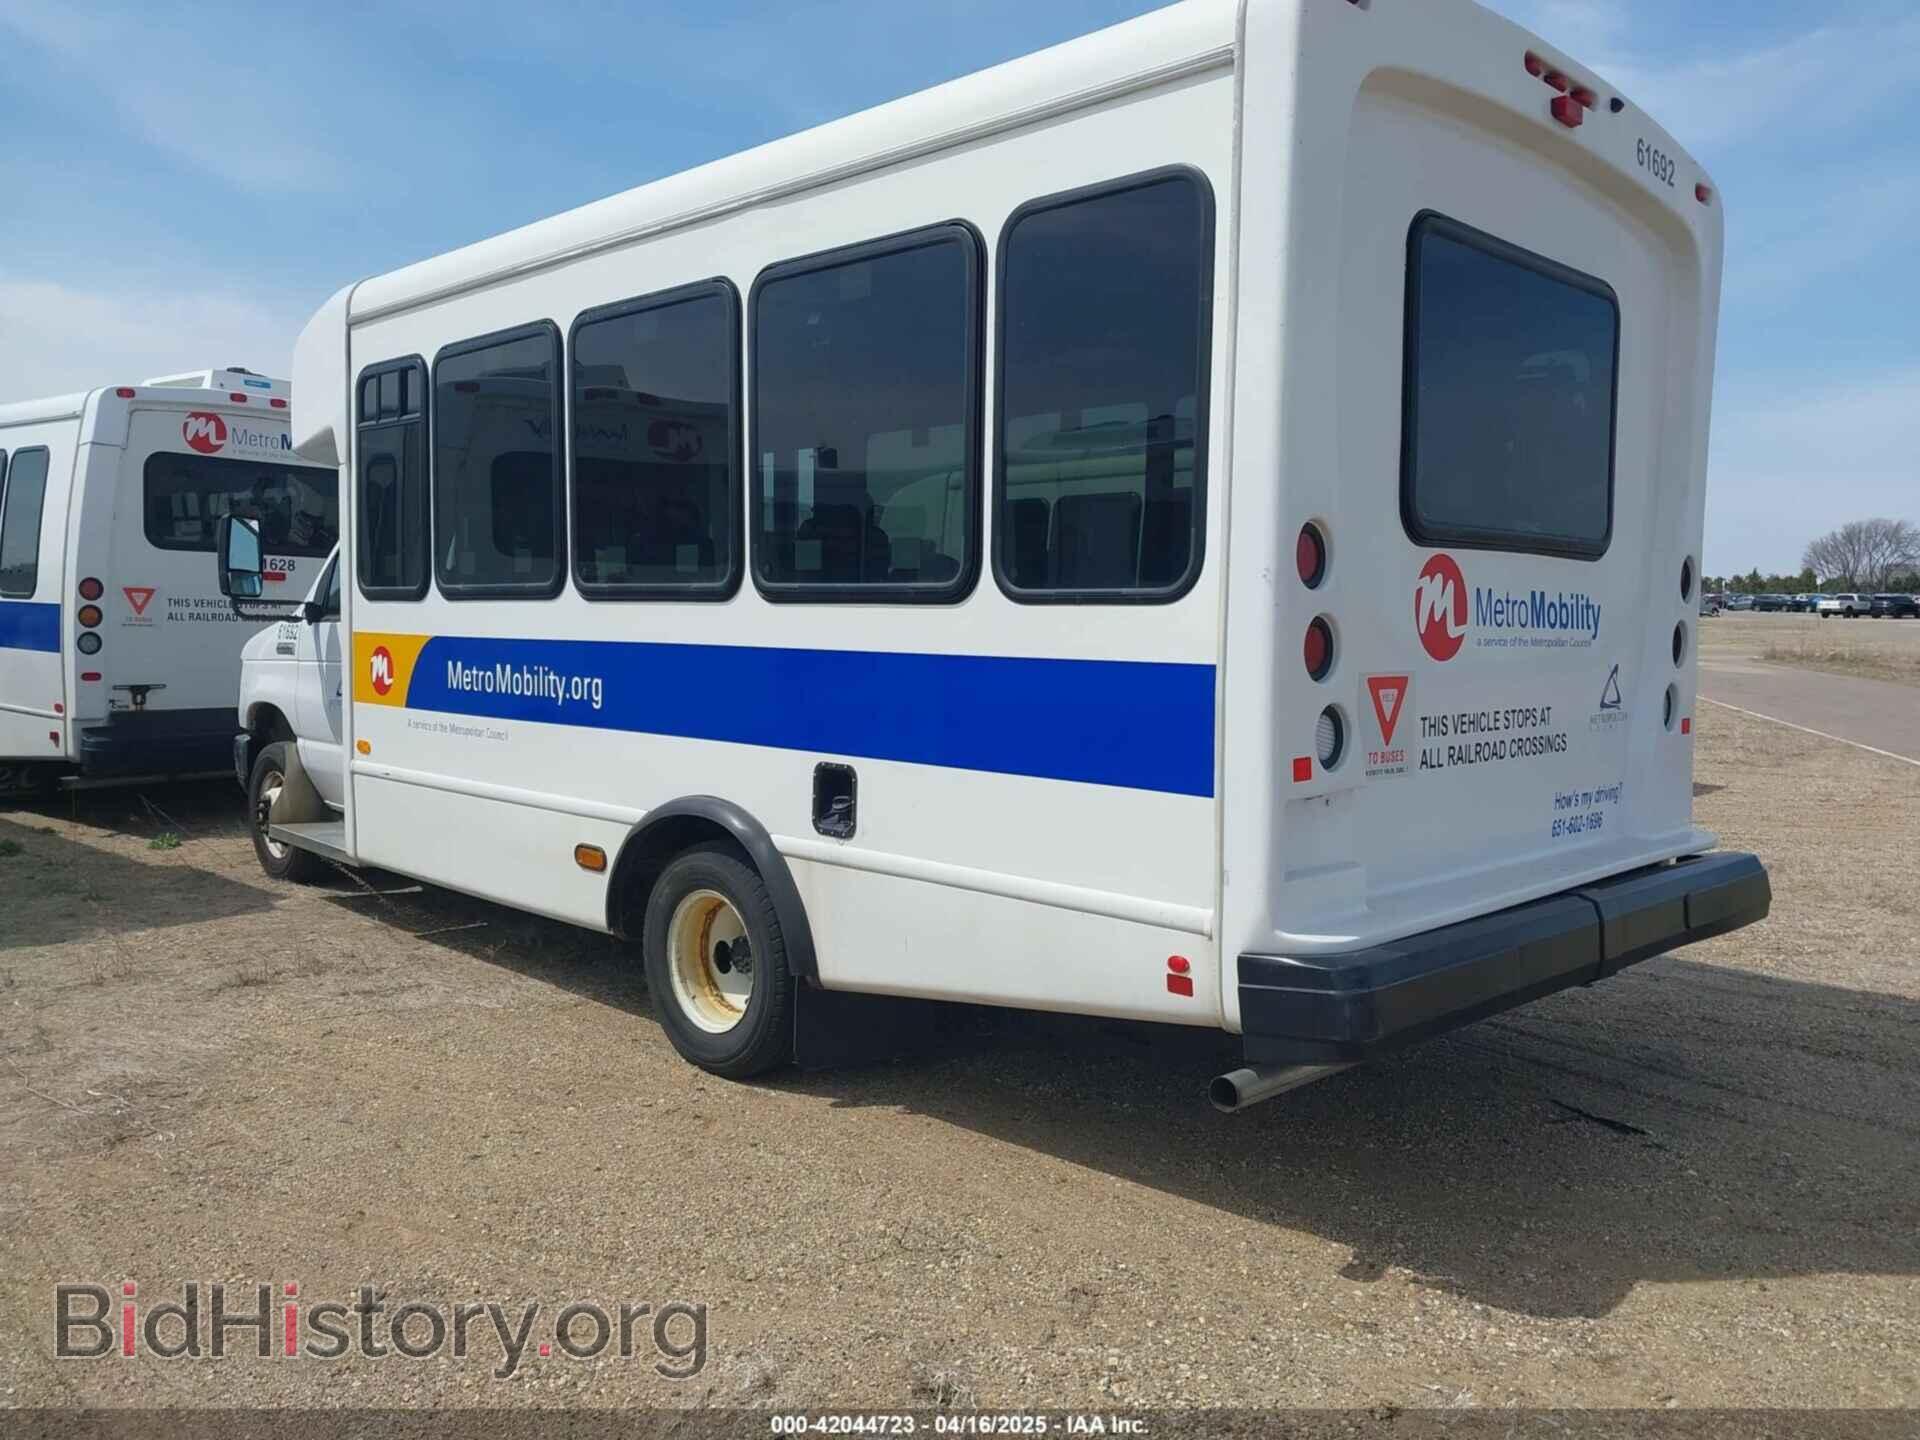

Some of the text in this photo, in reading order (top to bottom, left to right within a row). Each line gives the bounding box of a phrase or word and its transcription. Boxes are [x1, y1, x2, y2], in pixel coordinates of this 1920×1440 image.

[1636, 138, 1676, 187] 61692
[232, 427, 292, 450] MetroM
[264, 558, 296, 572] 1628
[167, 598, 190, 609] THIS
[167, 612, 184, 622] ALL
[188, 612, 239, 623] RAILROAD
[1476, 587, 1601, 640] MetroMobility
[447, 660, 602, 710] MetroMobility.org
[1420, 706, 1552, 738] THIS VEHICLE STOPS AT
[1367, 750, 1404, 764] TO BUSES
[1419, 733, 1568, 769] ALL RAILROAD CROSSINGS
[1554, 782, 1623, 810] How's my driving?
